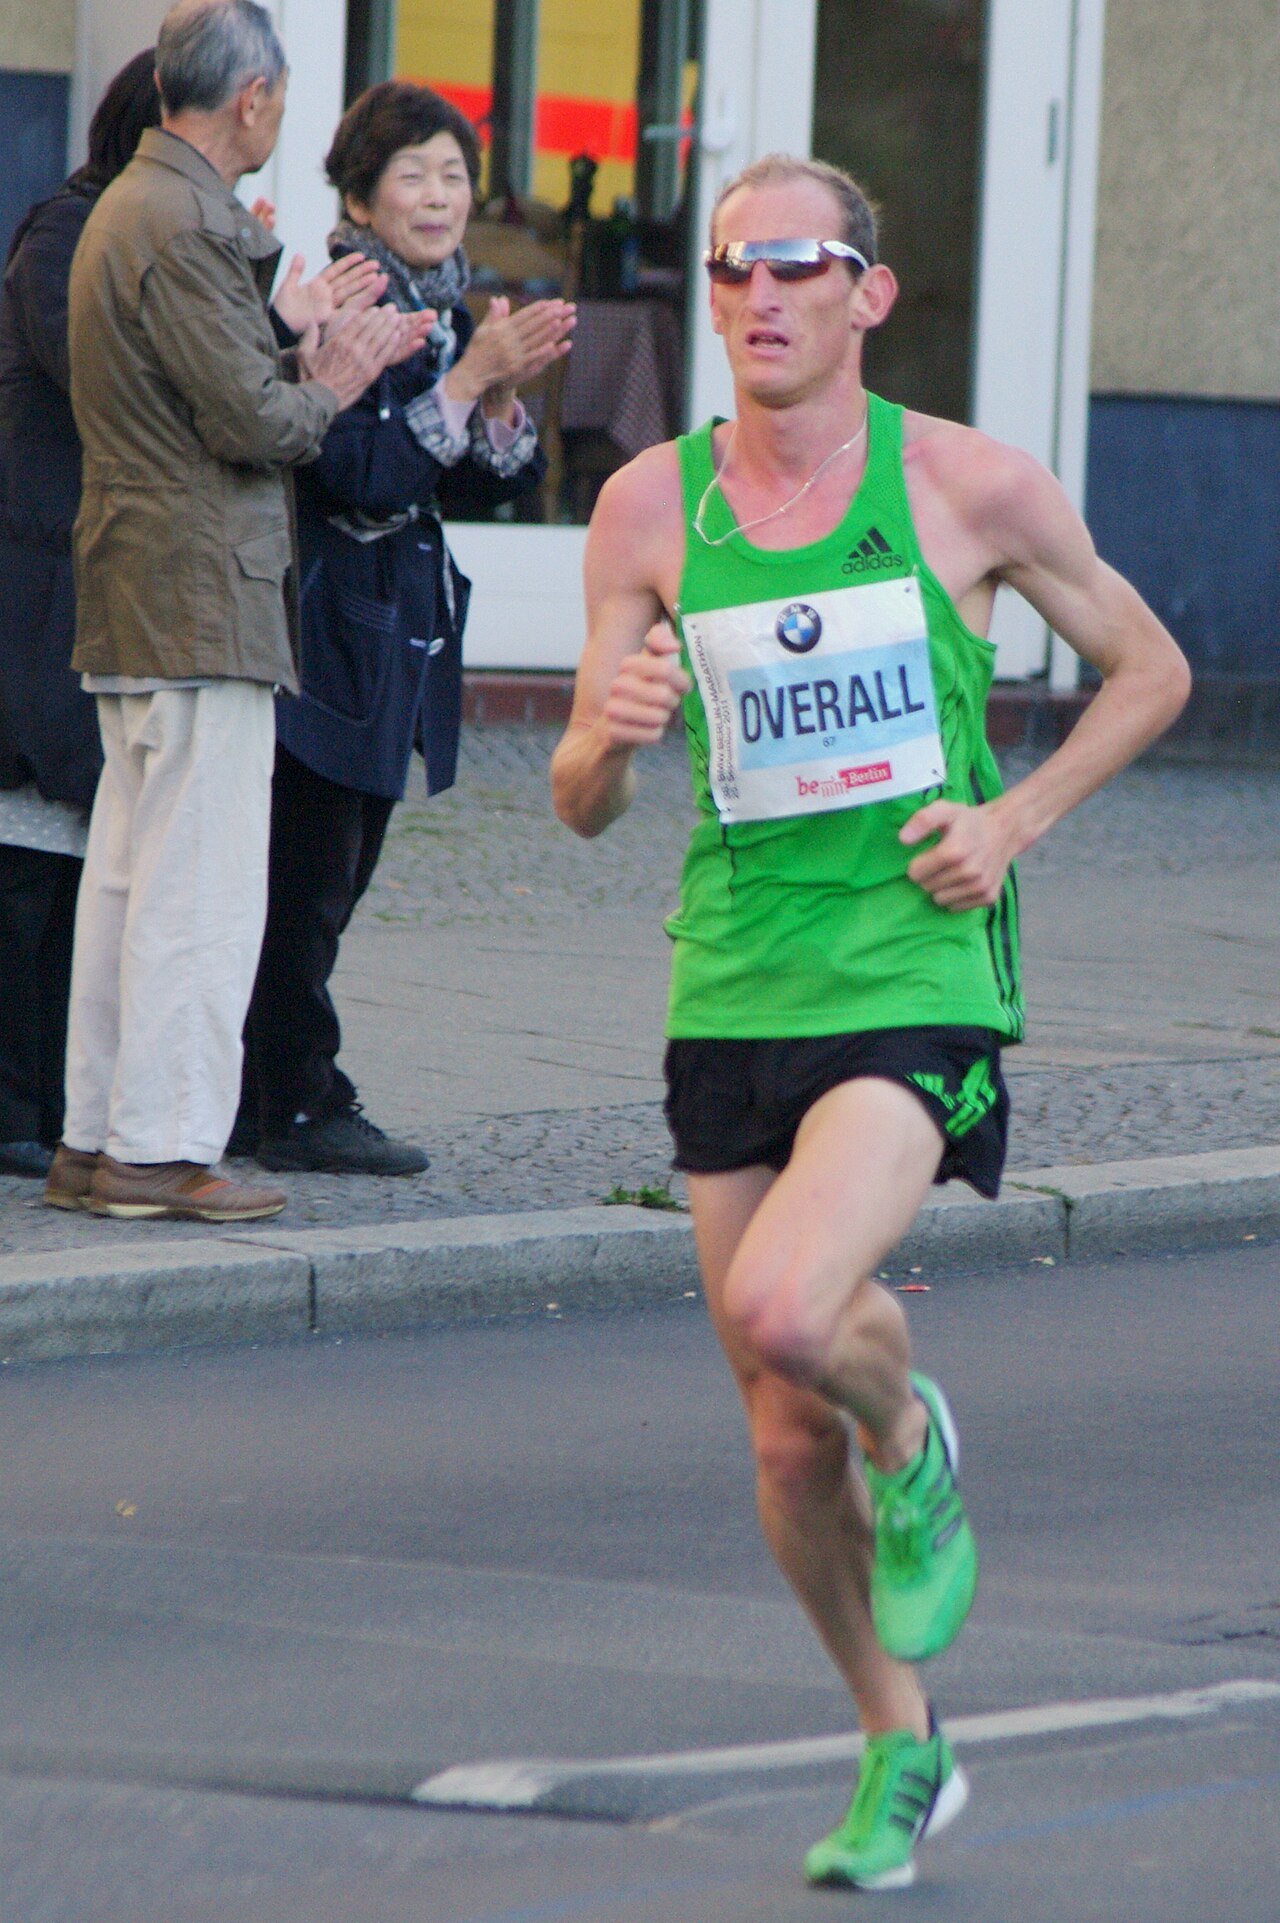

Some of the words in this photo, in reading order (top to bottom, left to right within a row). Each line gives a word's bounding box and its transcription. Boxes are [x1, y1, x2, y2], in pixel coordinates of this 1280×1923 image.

[841, 553, 903, 574] adidas
[777, 604, 817, 624] BMW
[720, 700, 731, 724] 2011
[739, 664, 925, 744] OVERALL
[822, 736, 836, 747] 67
[795, 776, 819, 795] be
[849, 767, 888, 784] Berlin
